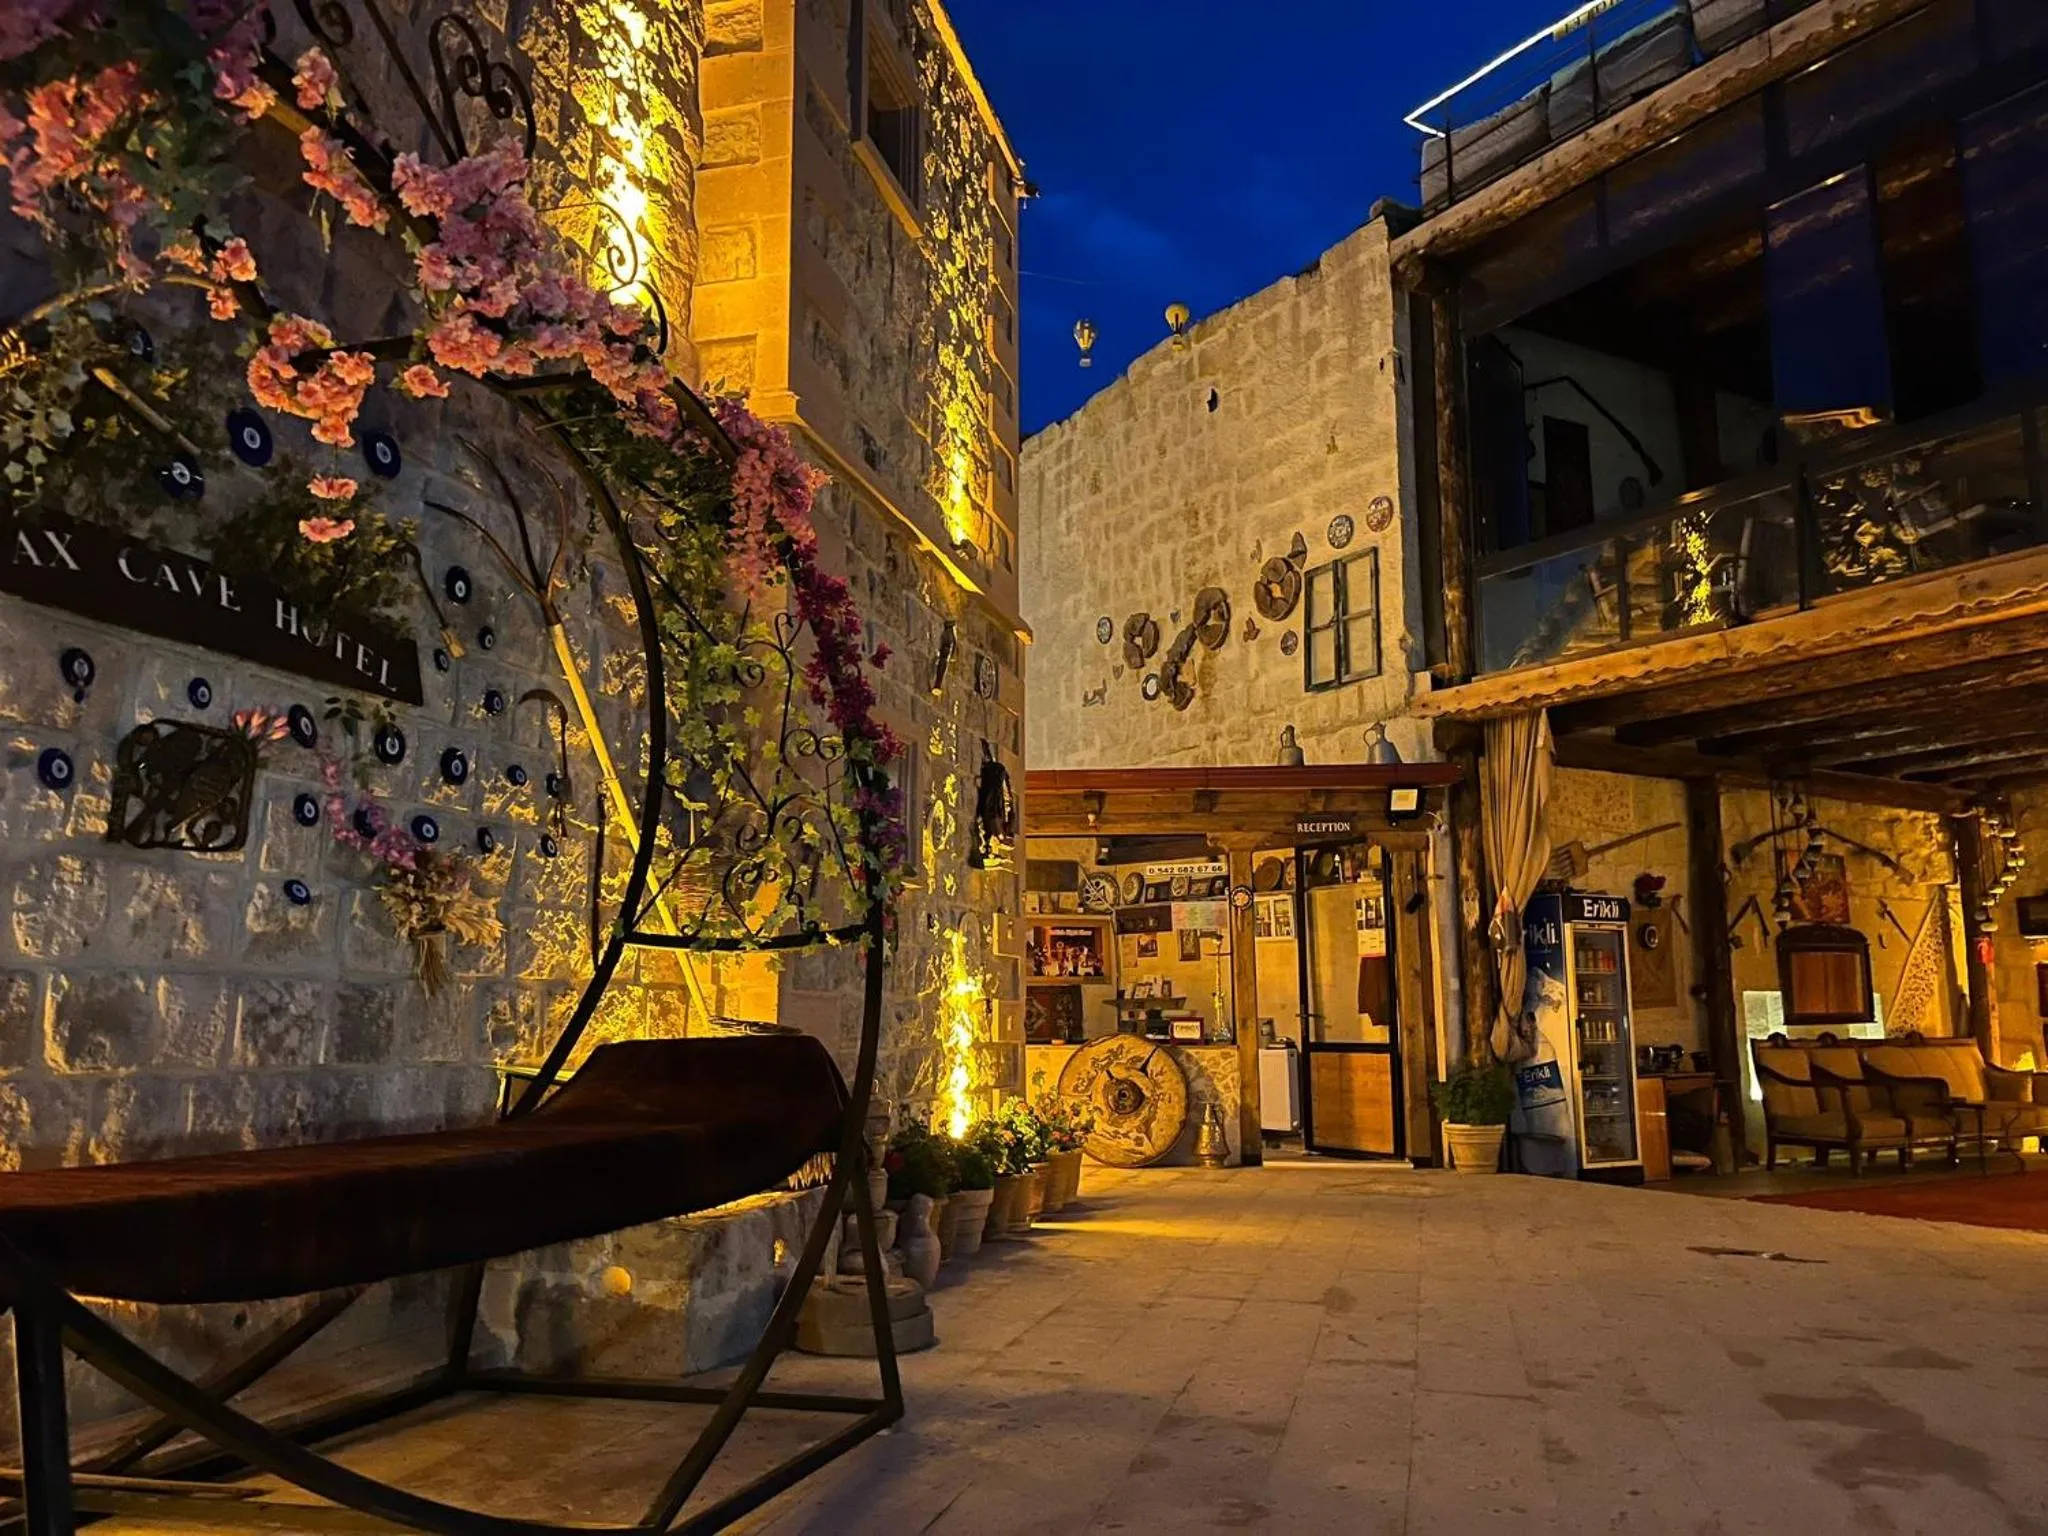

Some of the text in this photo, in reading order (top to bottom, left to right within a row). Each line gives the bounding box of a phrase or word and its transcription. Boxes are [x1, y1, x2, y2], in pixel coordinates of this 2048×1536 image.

[12, 529, 81, 571] AX
[117, 546, 242, 612] CAVE
[1296, 821, 1350, 832] RECEPTION
[1583, 899, 1620, 919] Erikli
